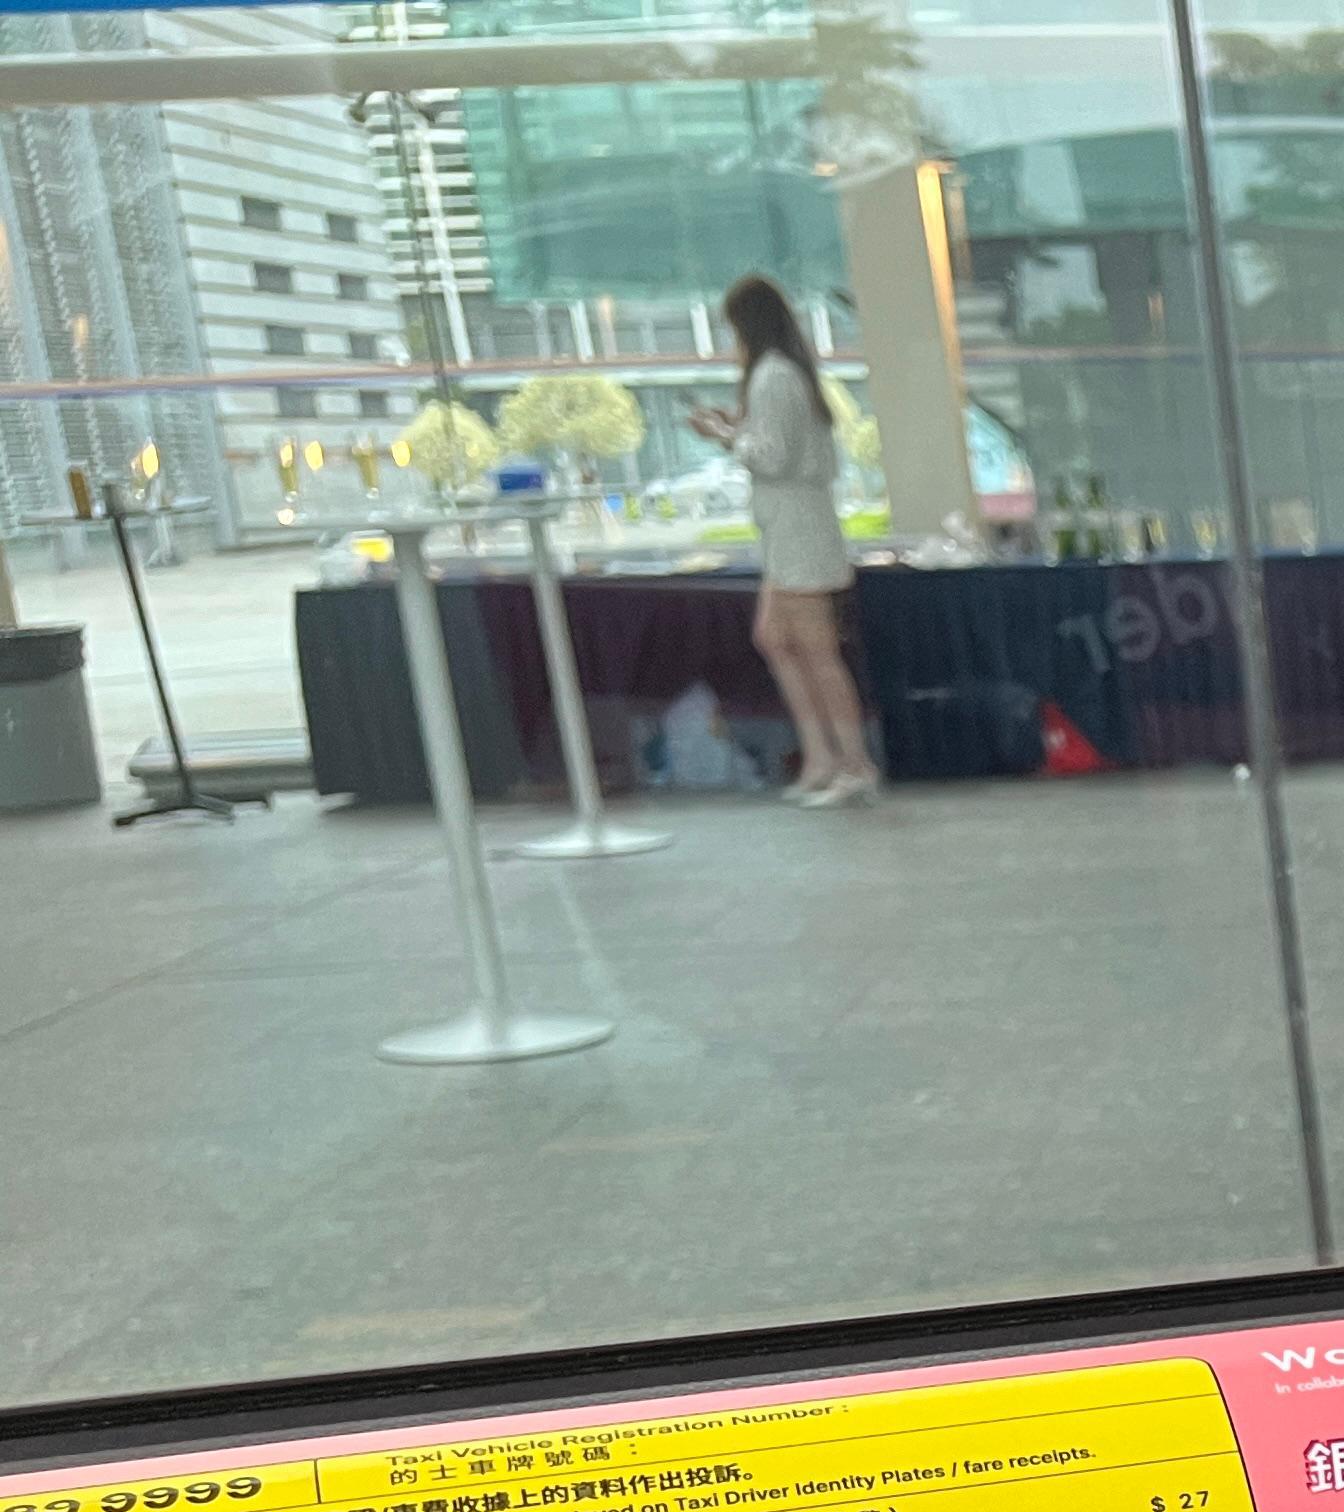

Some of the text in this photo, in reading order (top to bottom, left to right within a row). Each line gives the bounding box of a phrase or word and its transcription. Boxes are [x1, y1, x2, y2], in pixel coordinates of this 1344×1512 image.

[386, 1405, 835, 1466] Taxi Vehicle Registration Number
[673, 1492, 720, 1511] Taxi
[725, 1484, 790, 1505] Driver
[796, 1473, 875, 1496] Identity
[882, 1464, 946, 1486] Plates
[964, 1455, 1004, 1475] fare
[1008, 1445, 1098, 1470] receipts.
[1179, 1491, 1209, 1511] 27
